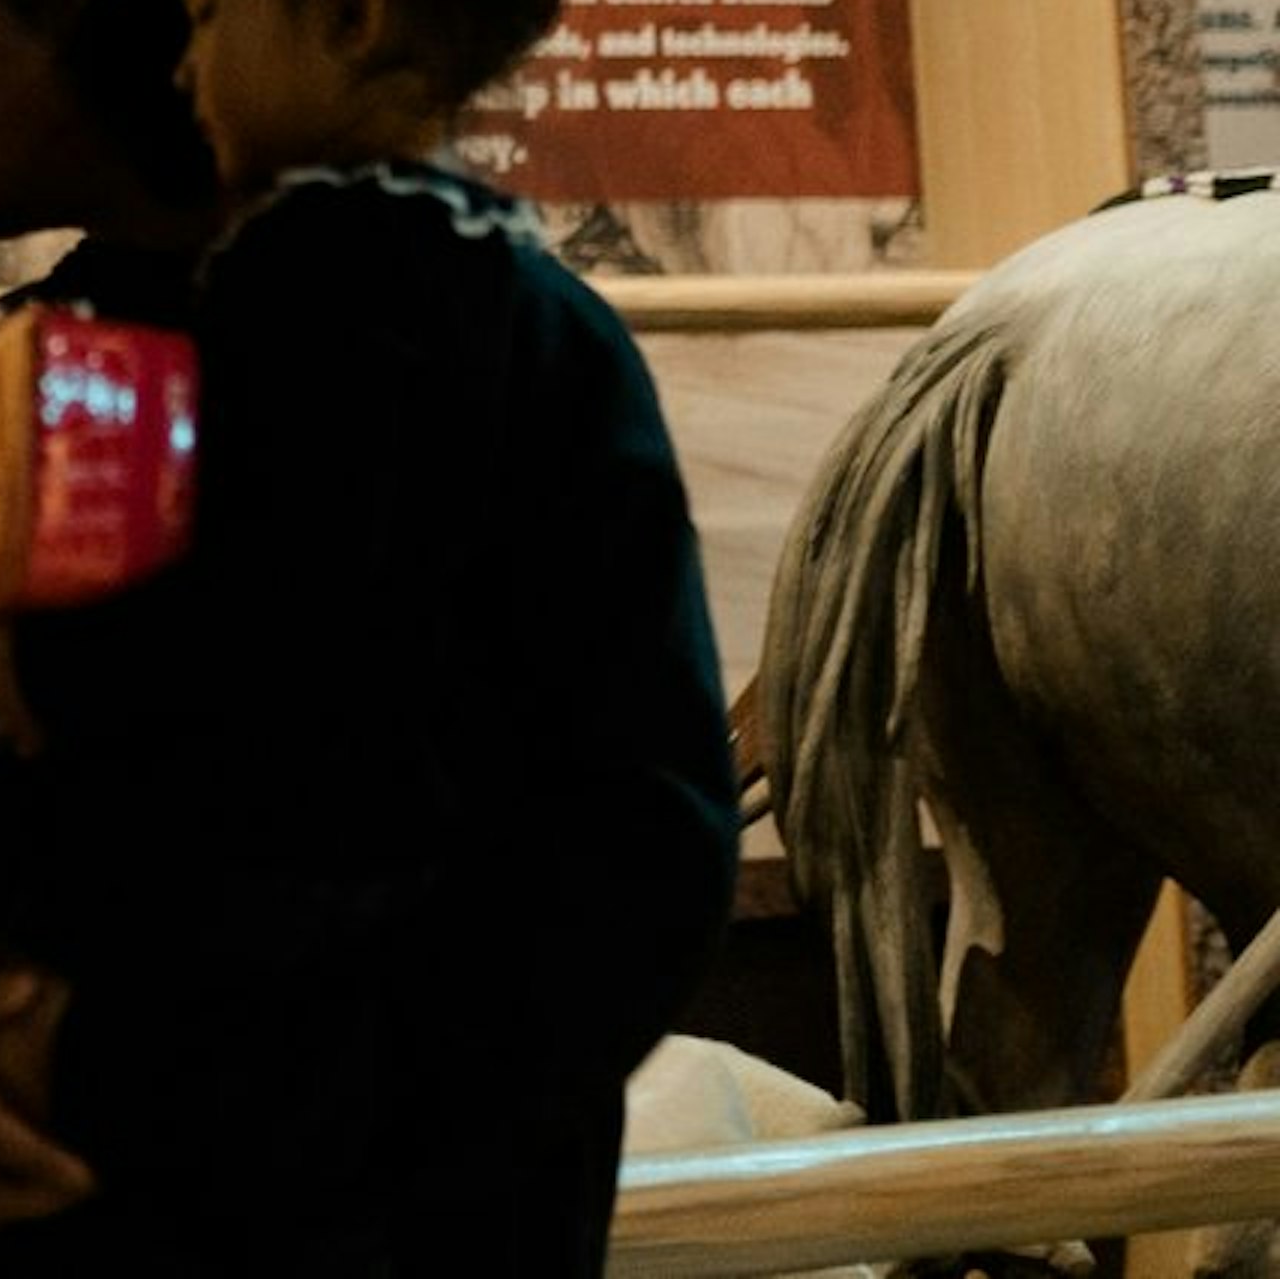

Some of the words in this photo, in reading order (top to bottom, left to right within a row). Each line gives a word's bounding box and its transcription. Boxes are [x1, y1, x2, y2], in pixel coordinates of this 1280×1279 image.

[557, 69, 599, 111] in
[604, 68, 719, 111] which
[726, 68, 814, 111] each
